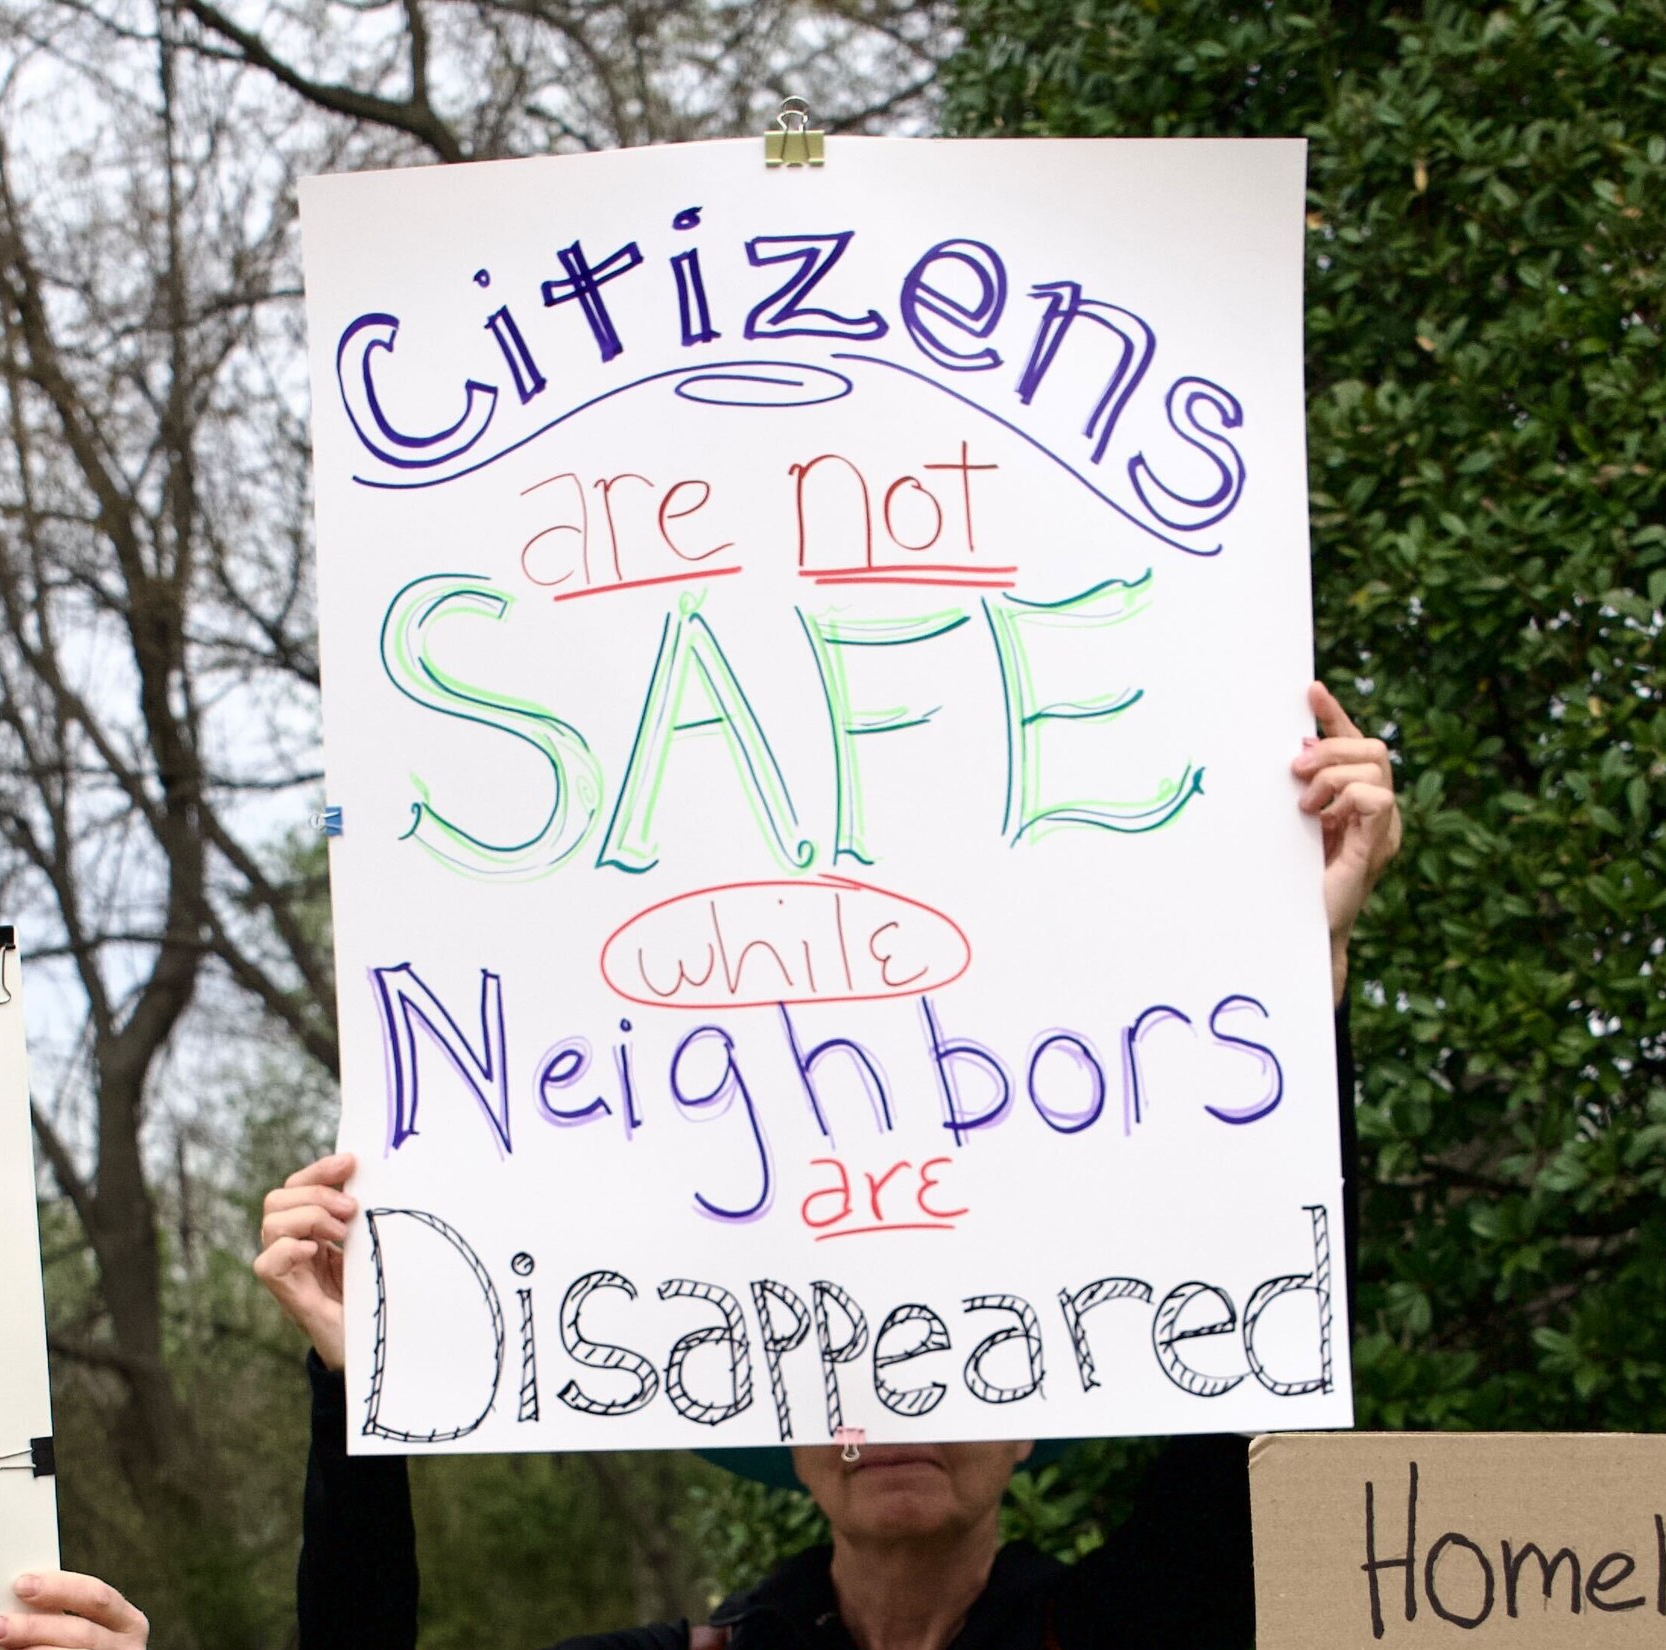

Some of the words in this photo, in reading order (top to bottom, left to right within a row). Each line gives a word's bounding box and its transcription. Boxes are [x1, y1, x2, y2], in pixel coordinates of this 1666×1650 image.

[336, 206, 1246, 533] Citizens
[520, 472, 734, 586] are
[787, 440, 1000, 567] not
[379, 567, 1207, 880] SAFE
[636, 893, 931, 998] while
[366, 961, 1285, 1225] Neighbors
[801, 1157, 970, 1229] are
[361, 1204, 1334, 1443] Disappeared
